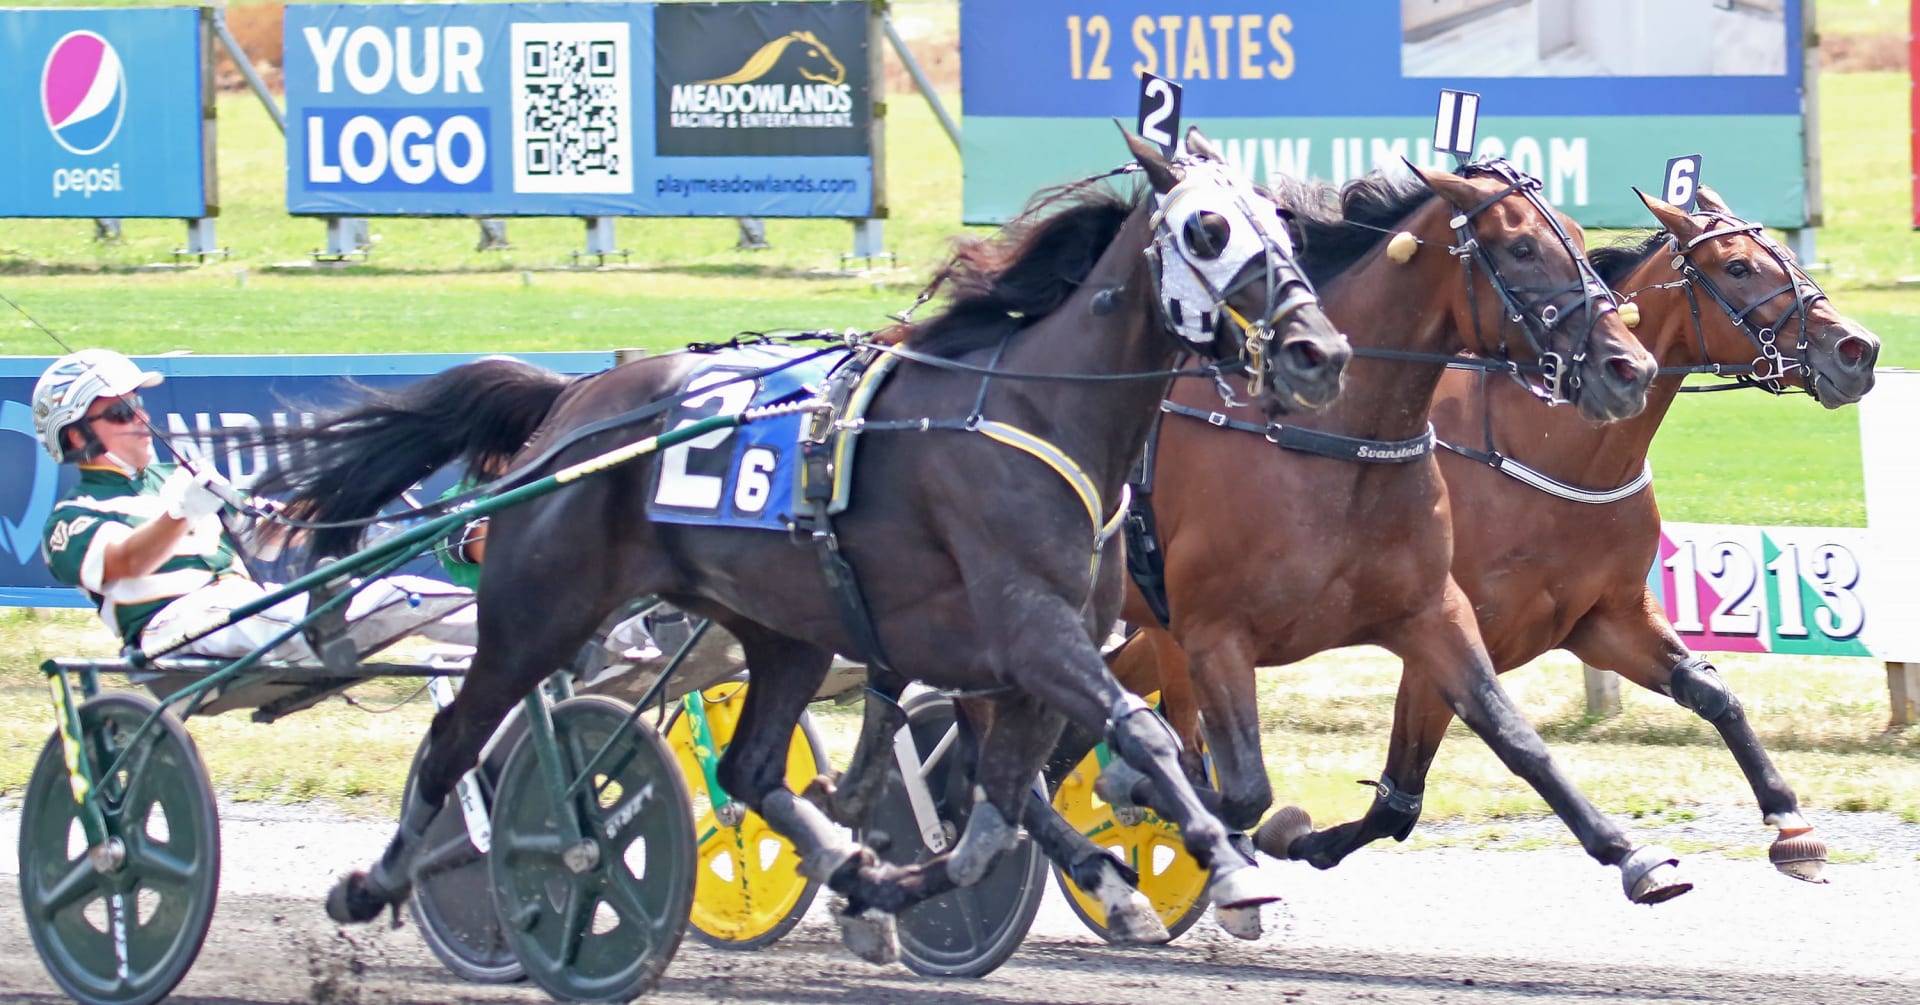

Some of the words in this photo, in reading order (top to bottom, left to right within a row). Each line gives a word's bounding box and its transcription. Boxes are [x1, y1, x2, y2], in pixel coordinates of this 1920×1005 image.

[302, 25, 485, 95] YOUR
[1066, 15, 1112, 80] 12
[1131, 14, 1295, 80] STATES
[669, 83, 853, 113] MEADOWLANDS
[669, 112, 725, 128] RACING
[726, 113, 738, 128] &
[1142, 77, 1175, 147] 2
[1434, 91, 1478, 154] 11
[53, 161, 123, 199] pepsi
[307, 114, 487, 185] LOGO
[656, 174, 857, 198] playmeadowlands.com
[1666, 157, 1695, 207] 6
[654, 370, 758, 510] 2
[1356, 443, 1425, 459] Svanstedt
[734, 447, 777, 513] 6
[1663, 540, 1762, 637] 12
[1766, 543, 1866, 642] 13
